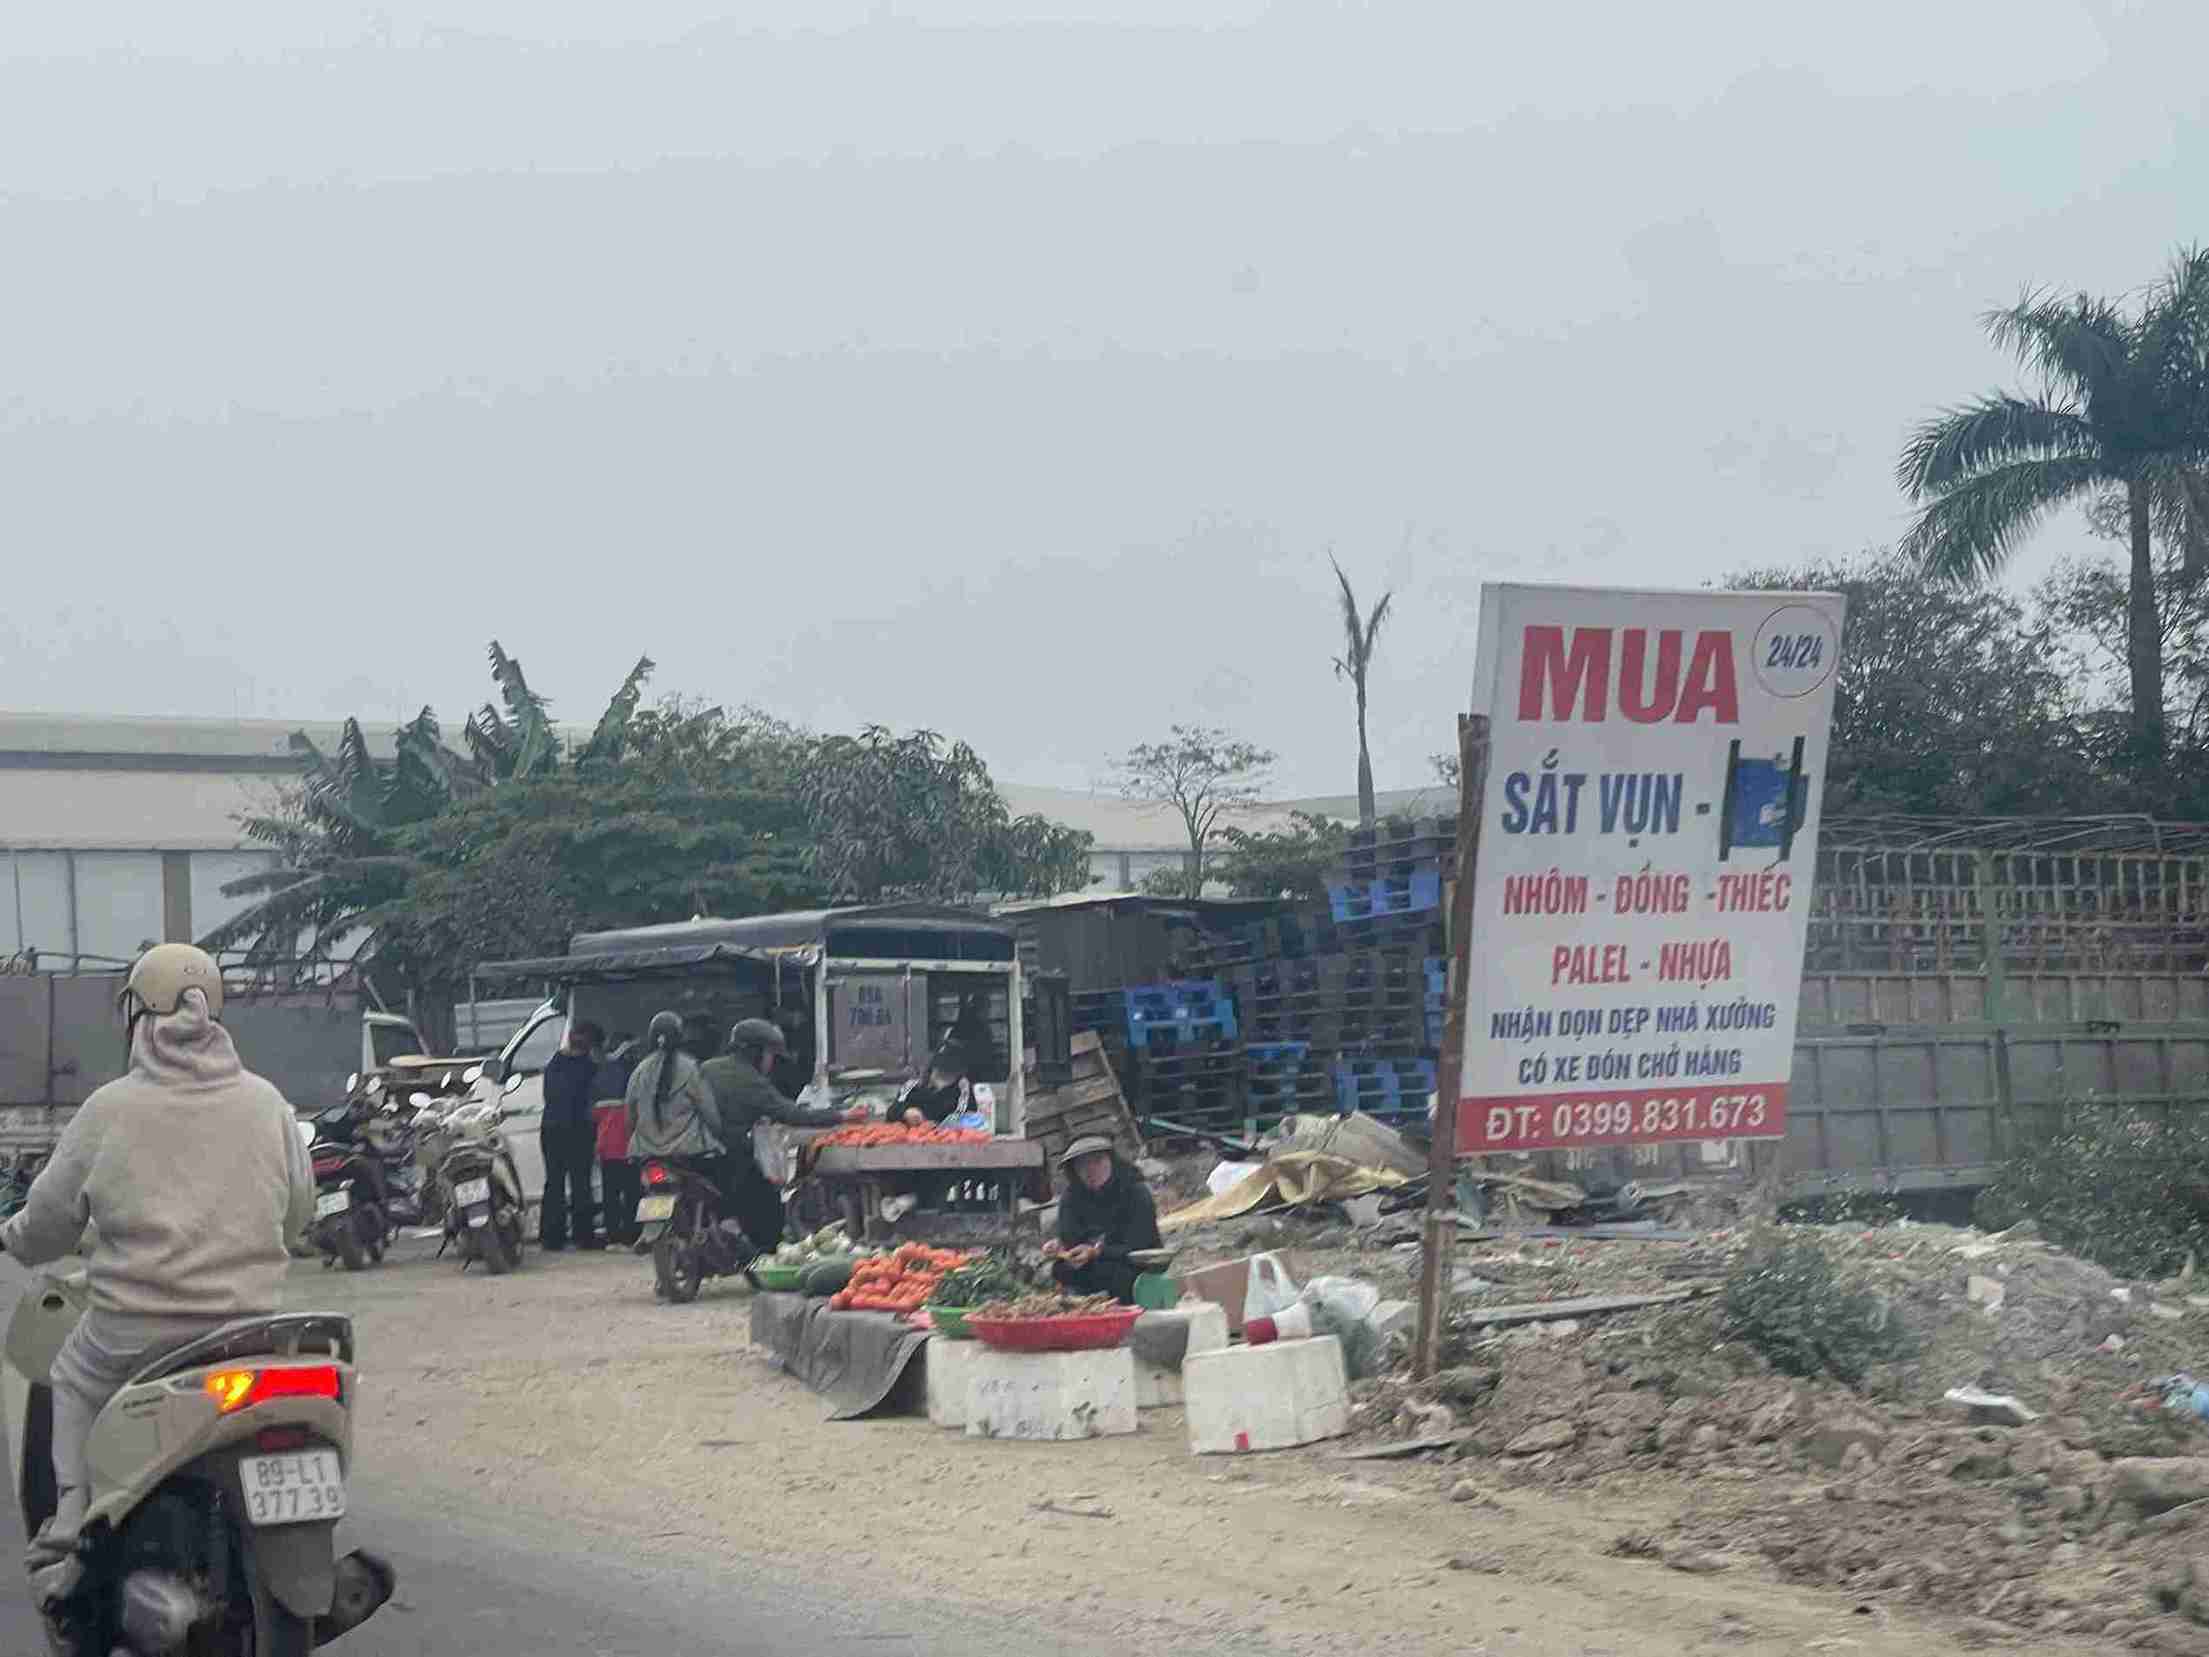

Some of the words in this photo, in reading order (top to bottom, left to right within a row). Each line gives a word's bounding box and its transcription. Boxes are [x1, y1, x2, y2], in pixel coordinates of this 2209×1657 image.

[1517, 625, 1739, 724] MUA
[1767, 634, 1823, 668] 24/24
[1500, 748, 1588, 834] SẮT
[1600, 773, 1683, 848] VỤN
[1504, 866, 1588, 914] NHÔM
[1552, 944, 1631, 984] PALEL
[1659, 938, 1731, 989] NHỰA
[1490, 1006, 1552, 1043] NHẬN
[1558, 1008, 1602, 1041] DỌN
[1608, 1007, 1649, 1039] DẸP
[1705, 996, 1775, 1031] XƯỞNG
[1519, 1052, 1547, 1084] CÓ
[1553, 1055, 1580, 1082] XE
[1637, 1041, 1681, 1077] CHỞ
[1486, 1106, 1541, 1141] ĐT:
[1553, 1095, 1767, 1137] 0399.831.673
